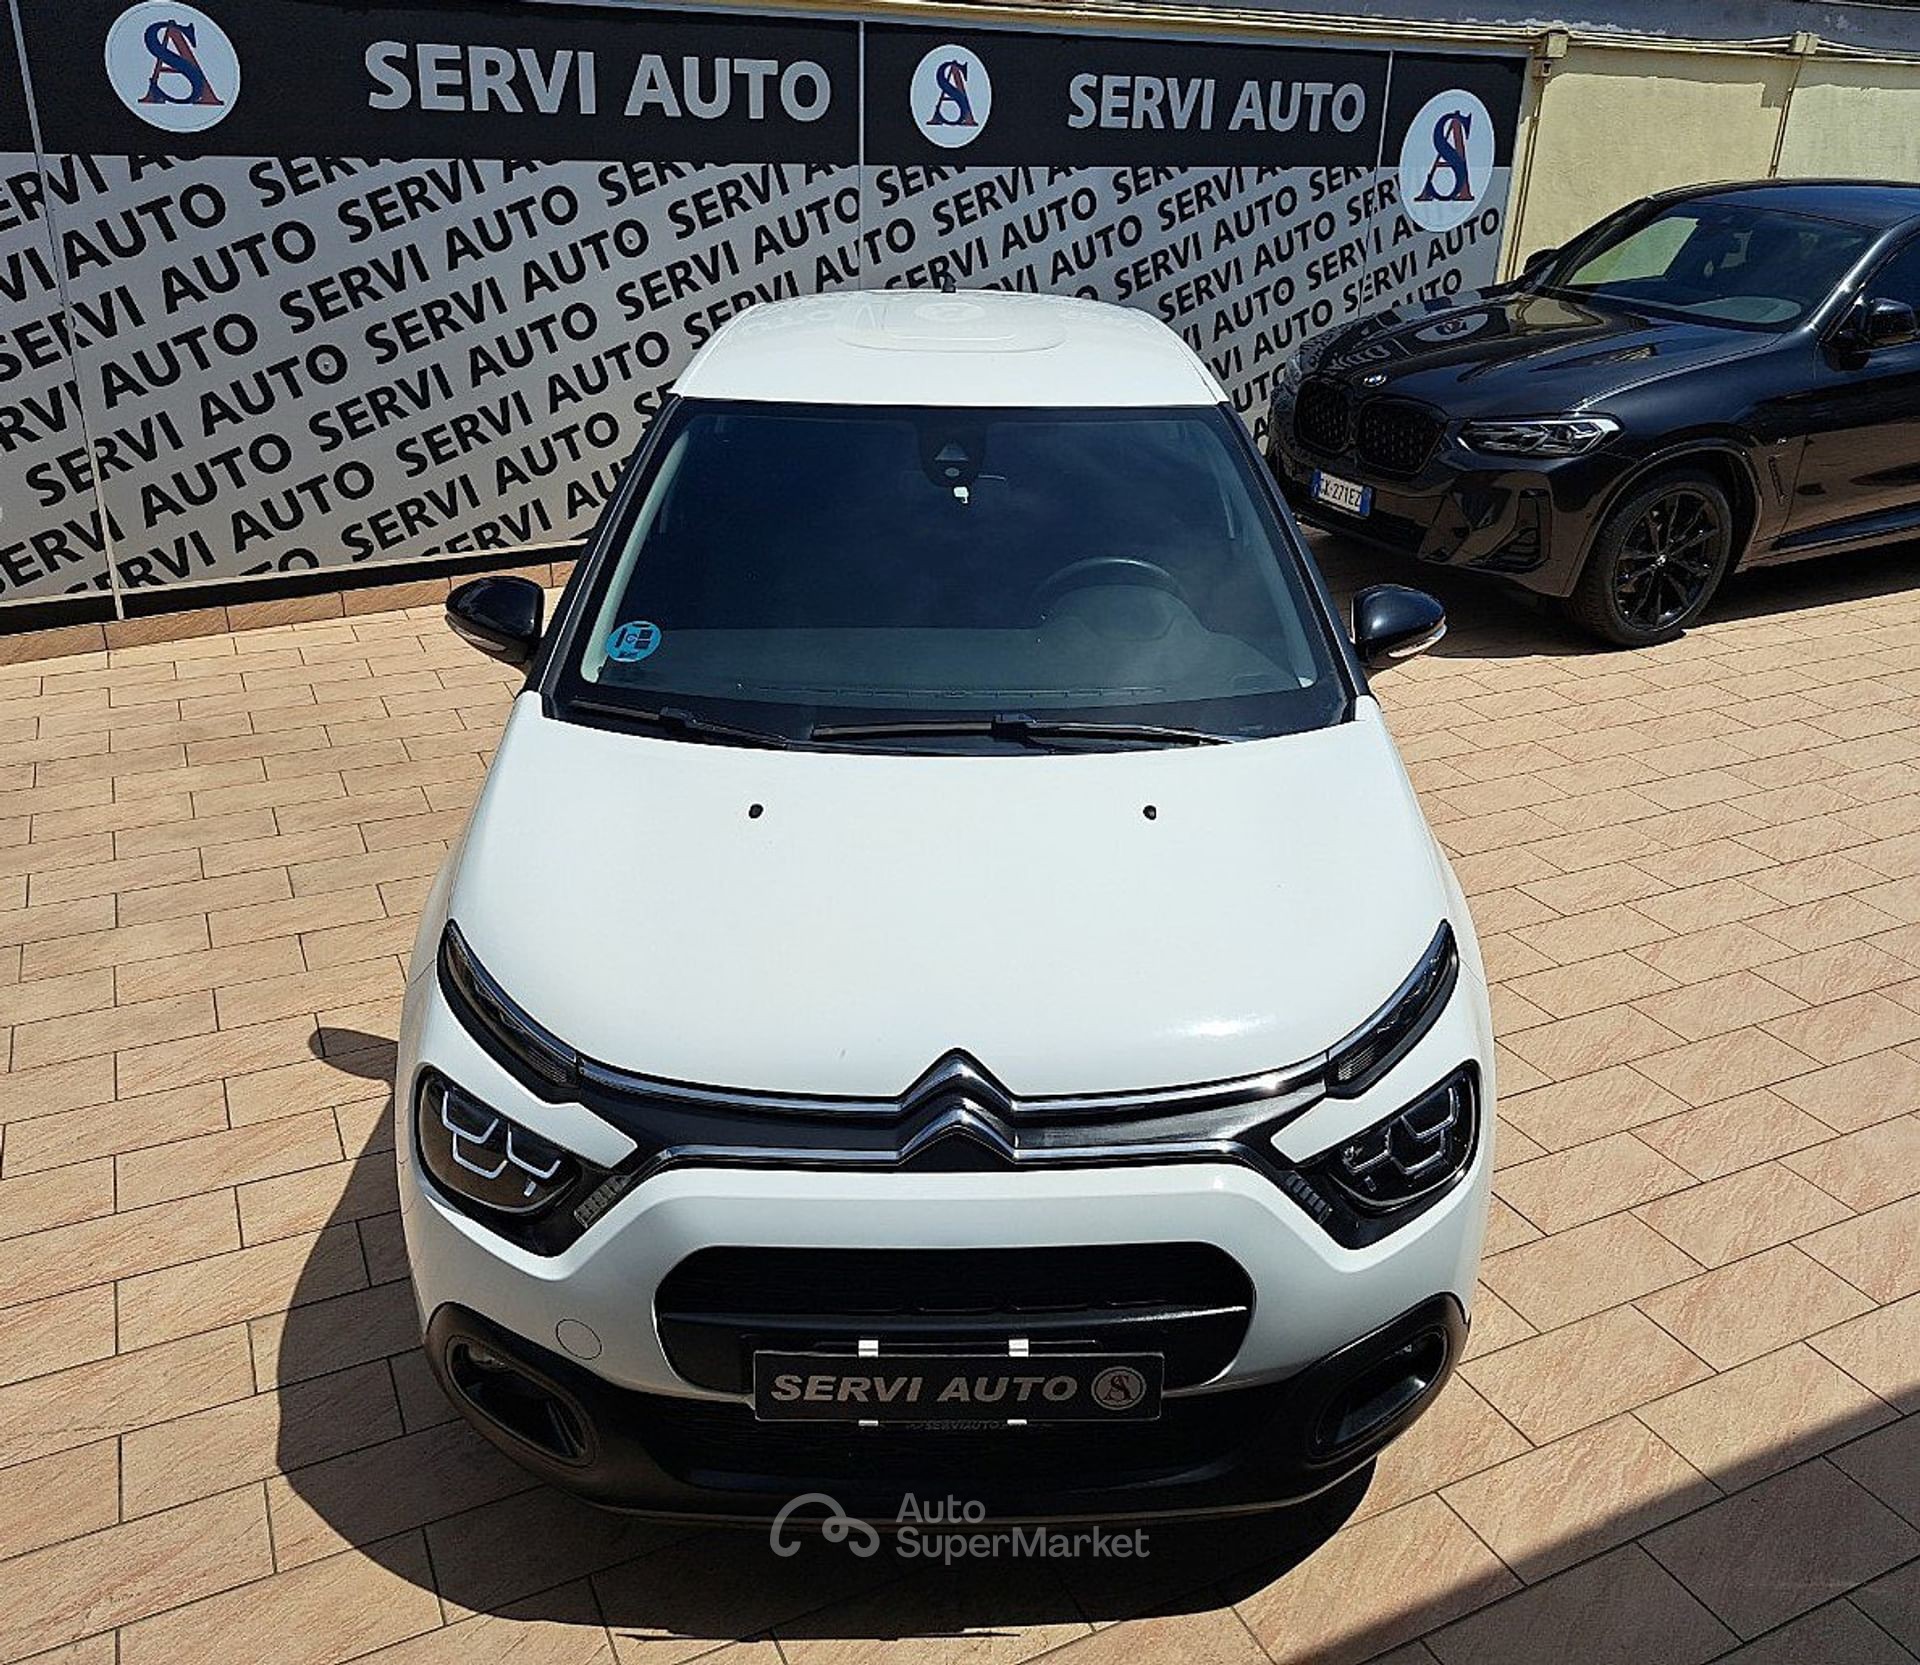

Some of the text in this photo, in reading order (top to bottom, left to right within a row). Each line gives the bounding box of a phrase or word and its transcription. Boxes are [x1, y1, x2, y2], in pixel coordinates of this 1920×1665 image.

[364, 40, 831, 122] SERVI AUTO
[1068, 73, 1365, 133] SERVI AUTO
[62, 183, 226, 280] AUTO
[162, 220, 317, 314] AUTO
[338, 158, 486, 243] SERVI
[1002, 187, 1097, 259] AUTO
[1051, 215, 1142, 285] AUTO
[1157, 168, 1245, 232] SERVI
[1114, 231, 1202, 301] SERVI
[1213, 185, 1298, 252] AUTO
[1157, 257, 1243, 324] SERVI
[1253, 211, 1335, 277] AUTO
[26, 163, 790, 507] SERVI AUTO SERVI AUTO SERVI
[100, 313, 258, 410] AUTO
[279, 243, 430, 334] SERVI
[446, 185, 578, 271] AUTO
[1212, 276, 1295, 343] AUTO
[1253, 299, 1333, 364] AUTO
[1343, 250, 1417, 313] SERVI
[1427, 207, 1499, 269] AUTO
[0, 505, 125, 593] ERVI
[140, 433, 292, 529] AUTO
[308, 363, 454, 452] SERVI
[468, 302, 597, 388] AUTO
[616, 240, 740, 321] SERVI
[754, 187, 861, 265] AUTO
[230, 460, 375, 554] AUTO
[395, 390, 533, 478] SERVI
[548, 331, 669, 414] AUTO
[815, 218, 916, 293] AUTO
[932, 167, 1035, 236] SERVI
[341, 411, 619, 562] SERVI AUTO
[771, 1375, 923, 1402] SERVI
[936, 1375, 1078, 1402] AUTO
